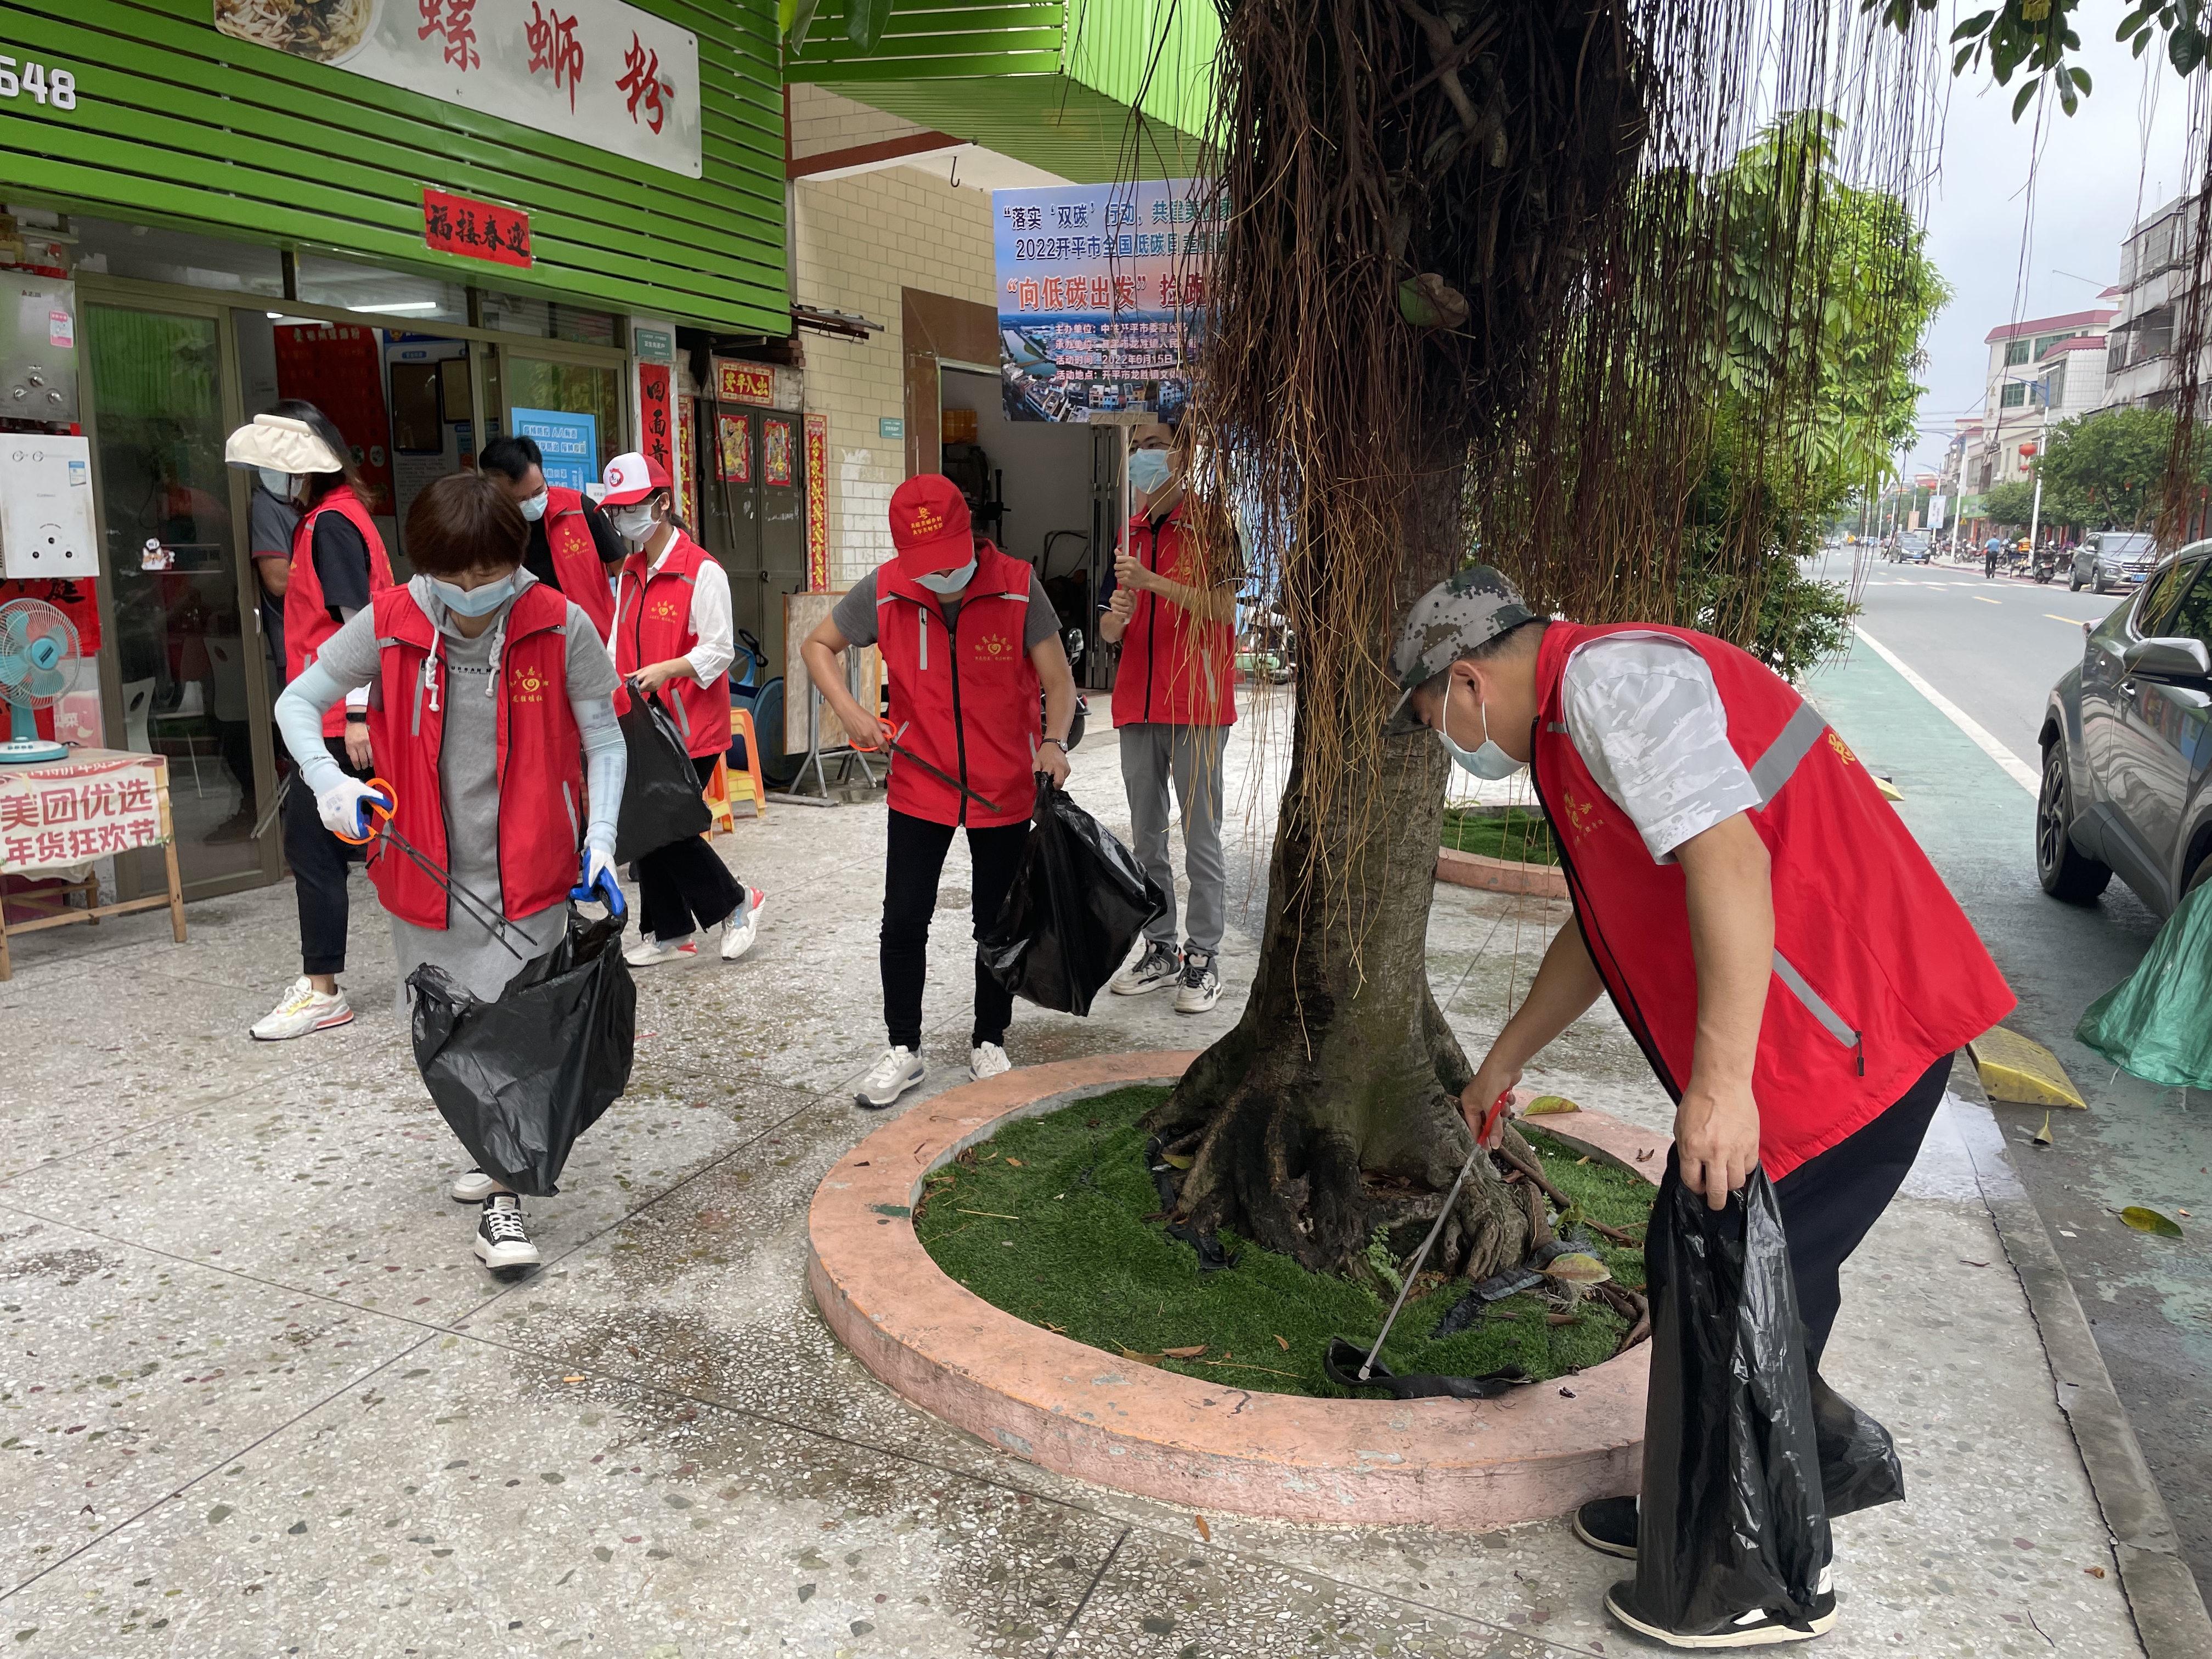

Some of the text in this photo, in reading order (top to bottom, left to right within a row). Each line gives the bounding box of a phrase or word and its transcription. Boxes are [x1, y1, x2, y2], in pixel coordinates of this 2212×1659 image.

[0, 778, 153, 832] 美团优选
[4, 818, 155, 866] 年货狂欢节
